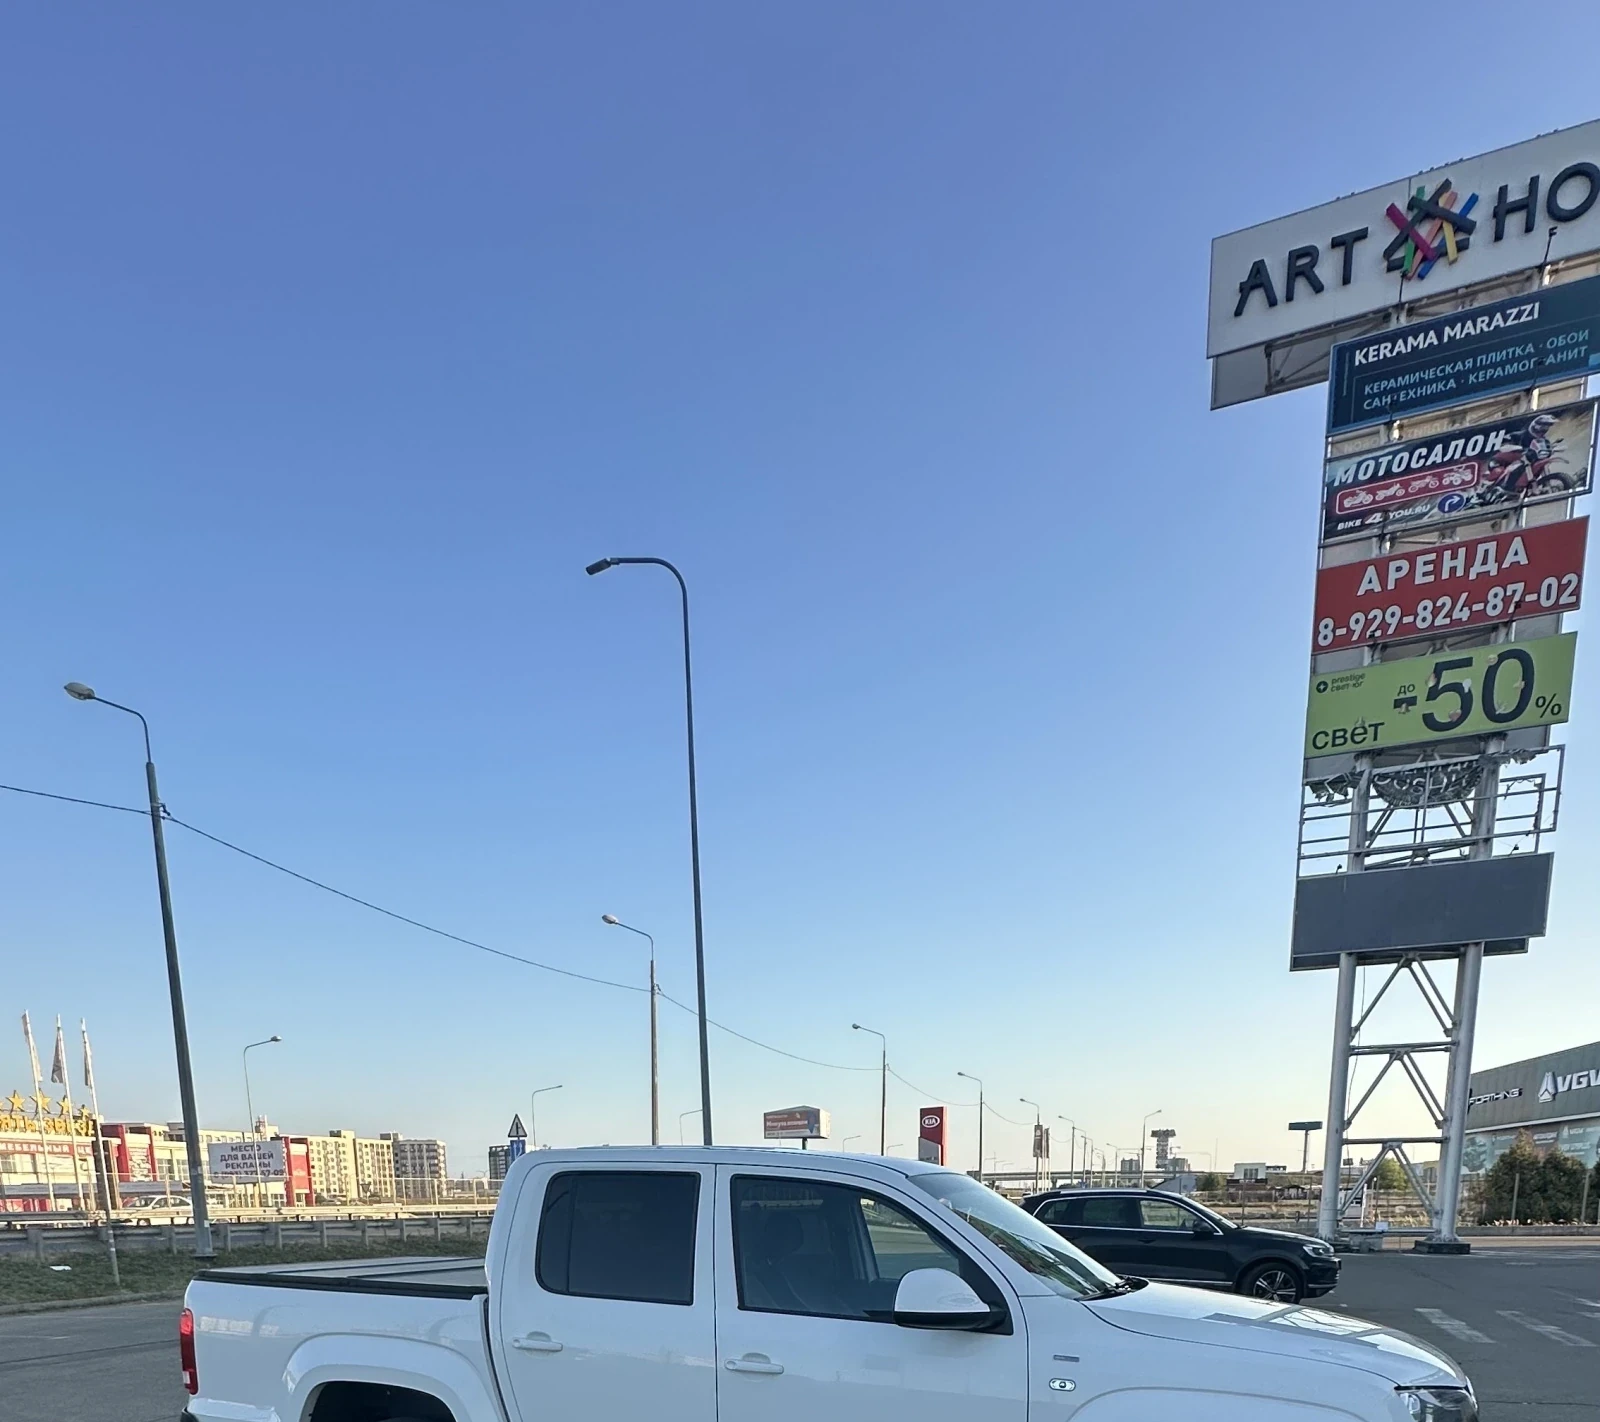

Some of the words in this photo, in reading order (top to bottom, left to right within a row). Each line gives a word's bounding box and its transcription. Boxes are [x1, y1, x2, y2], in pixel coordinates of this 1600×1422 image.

[1234, 227, 1369, 317] ART
[1354, 330, 1439, 366] KERAMA
[1443, 302, 1541, 344] MARAZZI
[1364, 357, 1473, 395] КЕРАМИЧЕСКАЯ
[1477, 343, 1535, 367] ПЛИТКА
[1546, 330, 1589, 349] ОБОИ
[1468, 346, 1588, 385] КЕРАМОГАНИТ
[1333, 430, 1506, 487] МОТОСАЛОН
[1337, 519, 1362, 530] BIKE
[1356, 536, 1529, 596] АРЕНДА
[1317, 573, 1580, 647] 8-929-824-87-02
[220, 1154, 239, 1162] ДЛЯ
